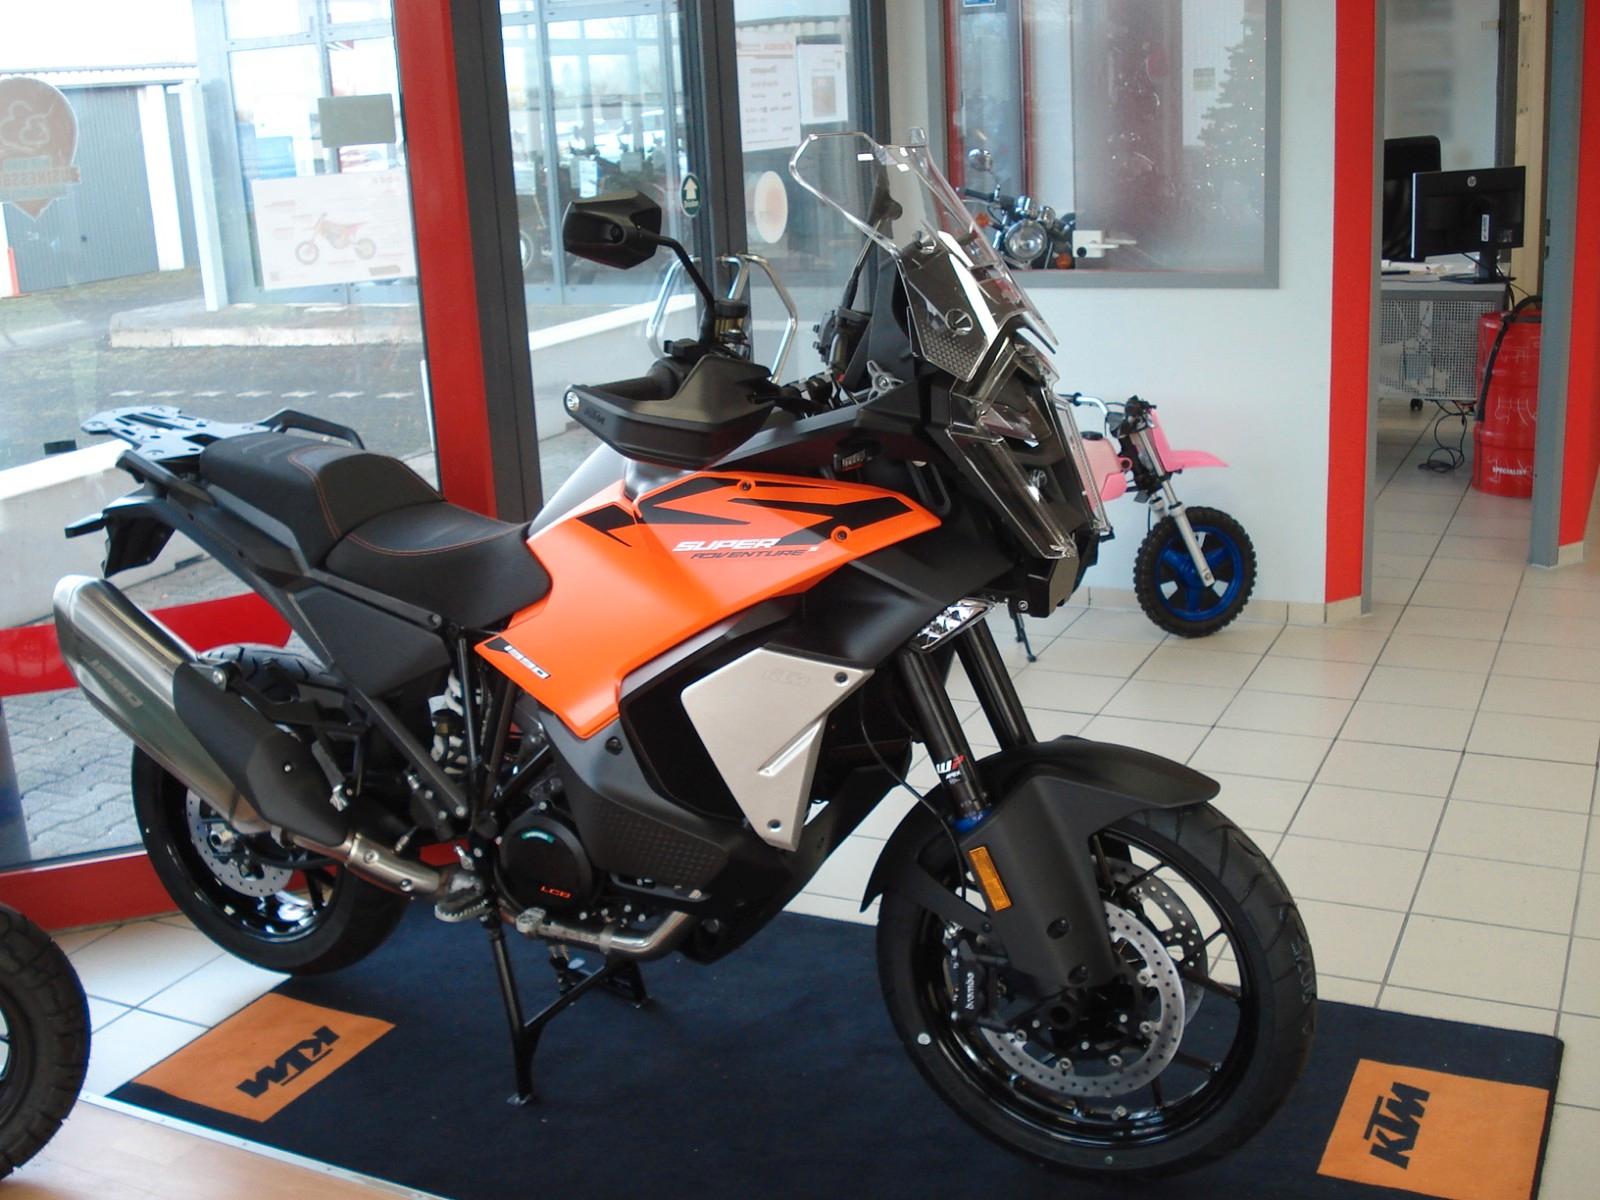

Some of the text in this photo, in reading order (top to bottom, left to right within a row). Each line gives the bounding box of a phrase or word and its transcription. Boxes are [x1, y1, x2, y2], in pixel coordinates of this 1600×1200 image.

[1492, 465, 1527, 476] SPECIALIST
[672, 537, 782, 552] SUPER
[690, 549, 806, 560] ADVENTURE
[236, 1025, 340, 1099] KTM
[1363, 1081, 1430, 1170] KTM
